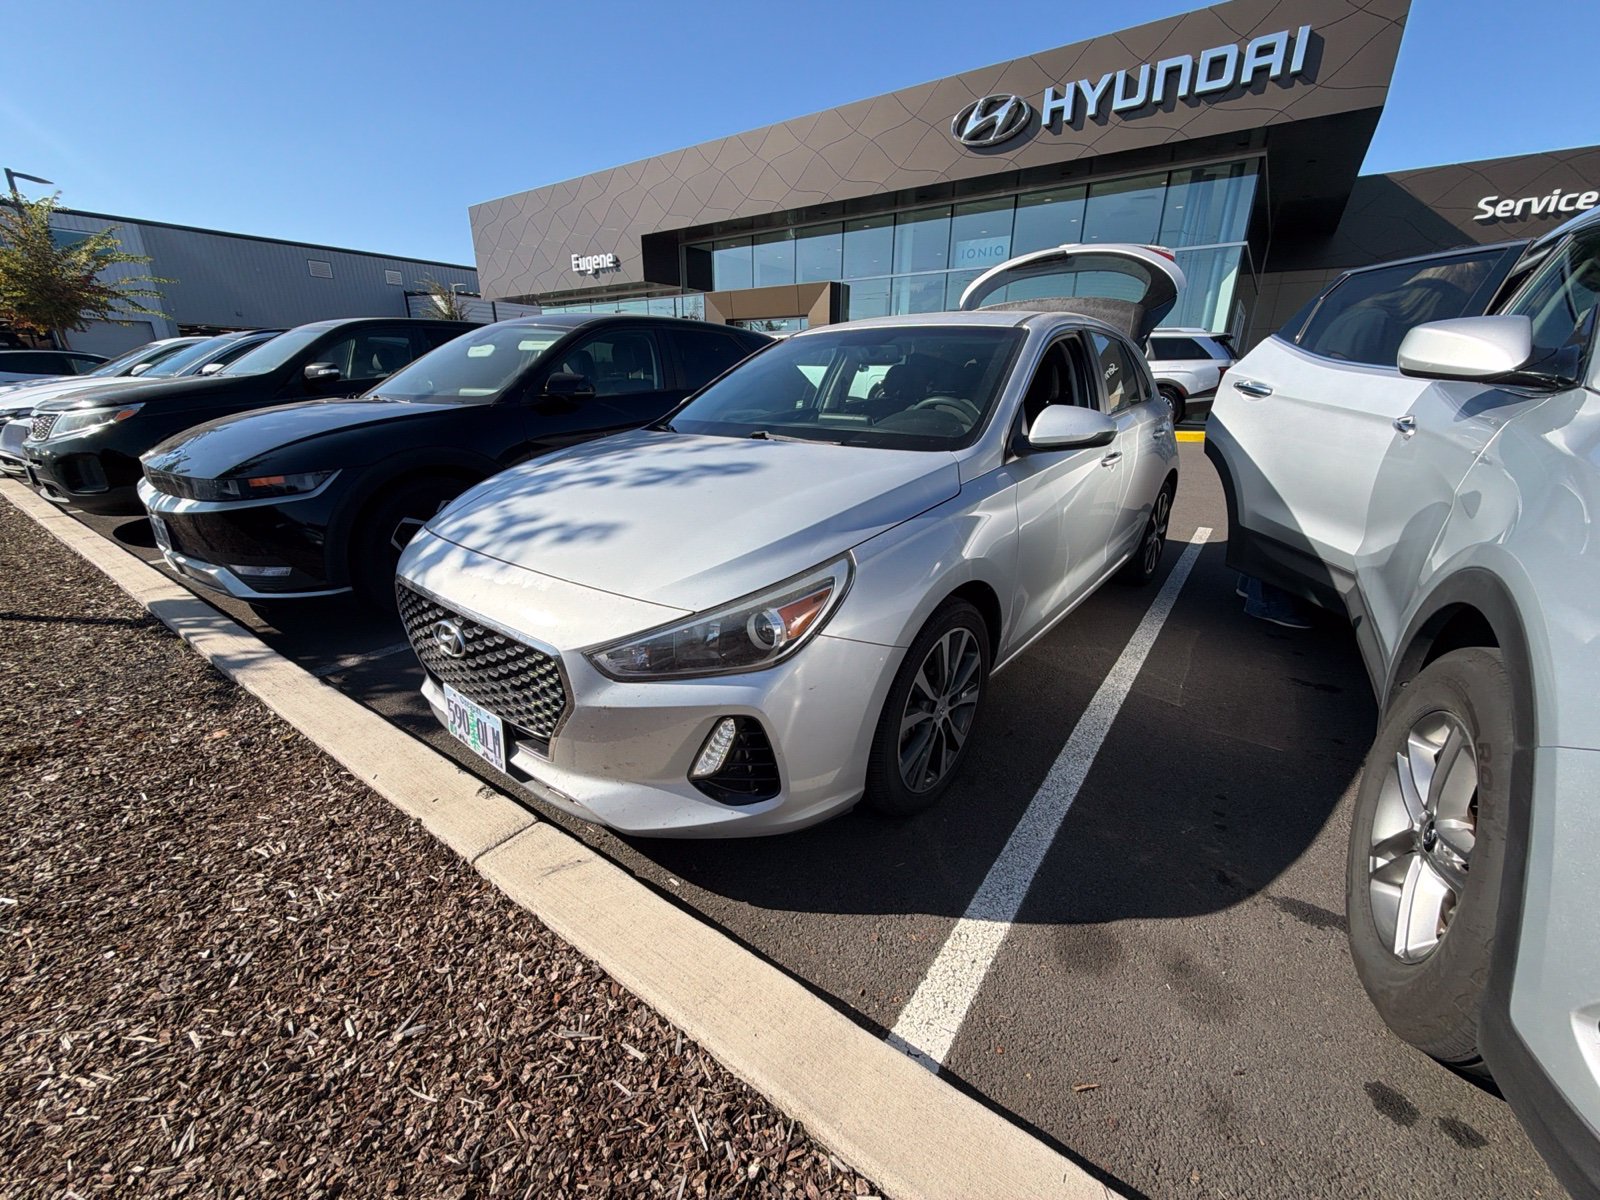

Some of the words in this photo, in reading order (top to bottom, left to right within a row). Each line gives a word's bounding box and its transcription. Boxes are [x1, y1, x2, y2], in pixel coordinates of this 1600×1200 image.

[1042, 25, 1312, 127] HYUNDAI
[1473, 188, 1599, 220] Service
[571, 253, 614, 275] Eugene
[447, 697, 470, 736] 590
